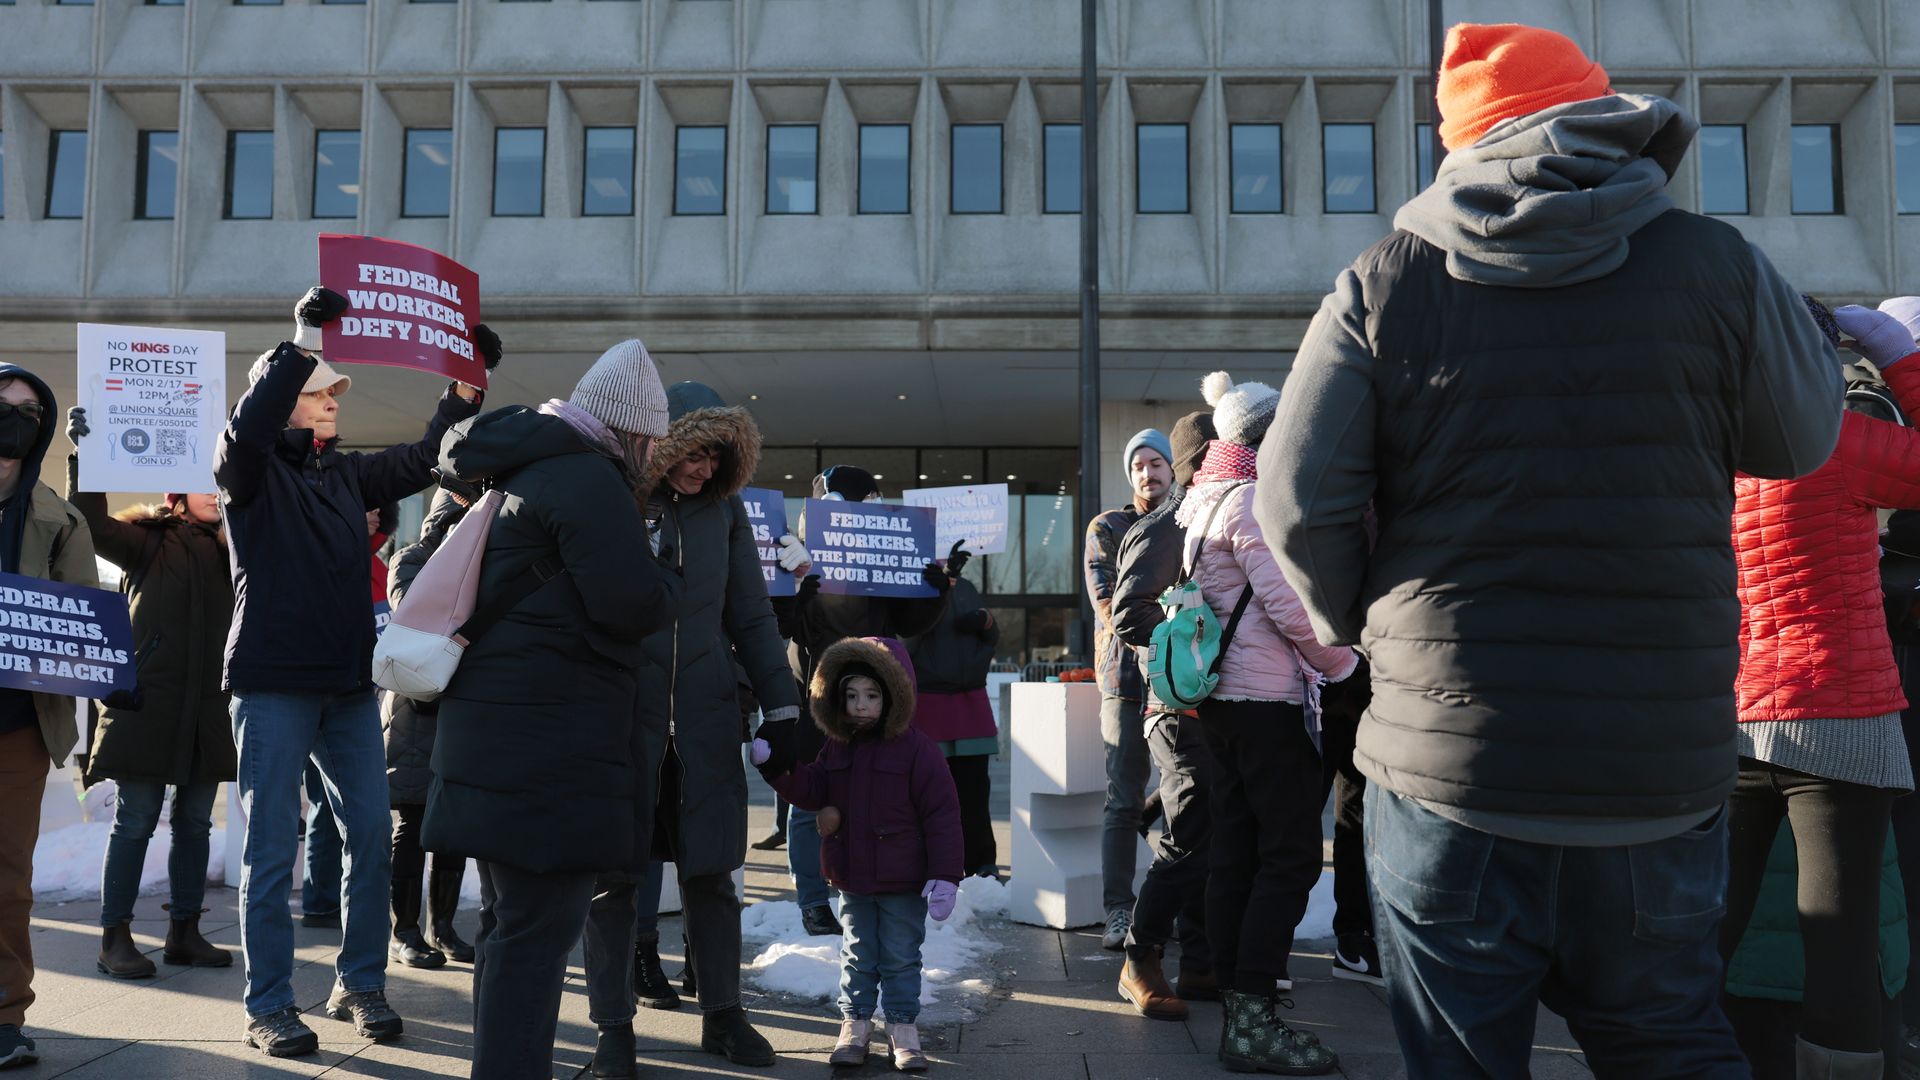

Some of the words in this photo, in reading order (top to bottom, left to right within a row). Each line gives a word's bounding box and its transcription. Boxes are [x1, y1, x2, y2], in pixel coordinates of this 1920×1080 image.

[358, 263, 462, 305] FEDERAL
[347, 289, 469, 337] WORKERS,
[107, 341, 128, 351] NO
[131, 342, 170, 354] KINGS
[173, 345, 198, 355] DAY
[340, 316, 413, 341] DEFY
[418, 325, 474, 361] DOGE!
[109, 357, 197, 375] PROTEST
[124, 377, 154, 387] MON
[156, 378, 182, 389] 2/17
[138, 390, 169, 401] 12PM
[120, 405, 155, 414] UNION
[158, 406, 198, 417] SQUARE
[136, 456, 158, 465] JOIN
[160, 457, 172, 466] US
[830, 512, 912, 533] FEDERAL
[822, 531, 919, 555] WORKERS,
[811, 549, 843, 564] THE
[846, 553, 899, 568] PUBLIC
[822, 567, 868, 582] YOUR
[872, 569, 923, 586] BACK!
[0, 586, 96, 617] DERAL
[83, 644, 129, 665] HAS
[38, 657, 114, 684] BACK!
